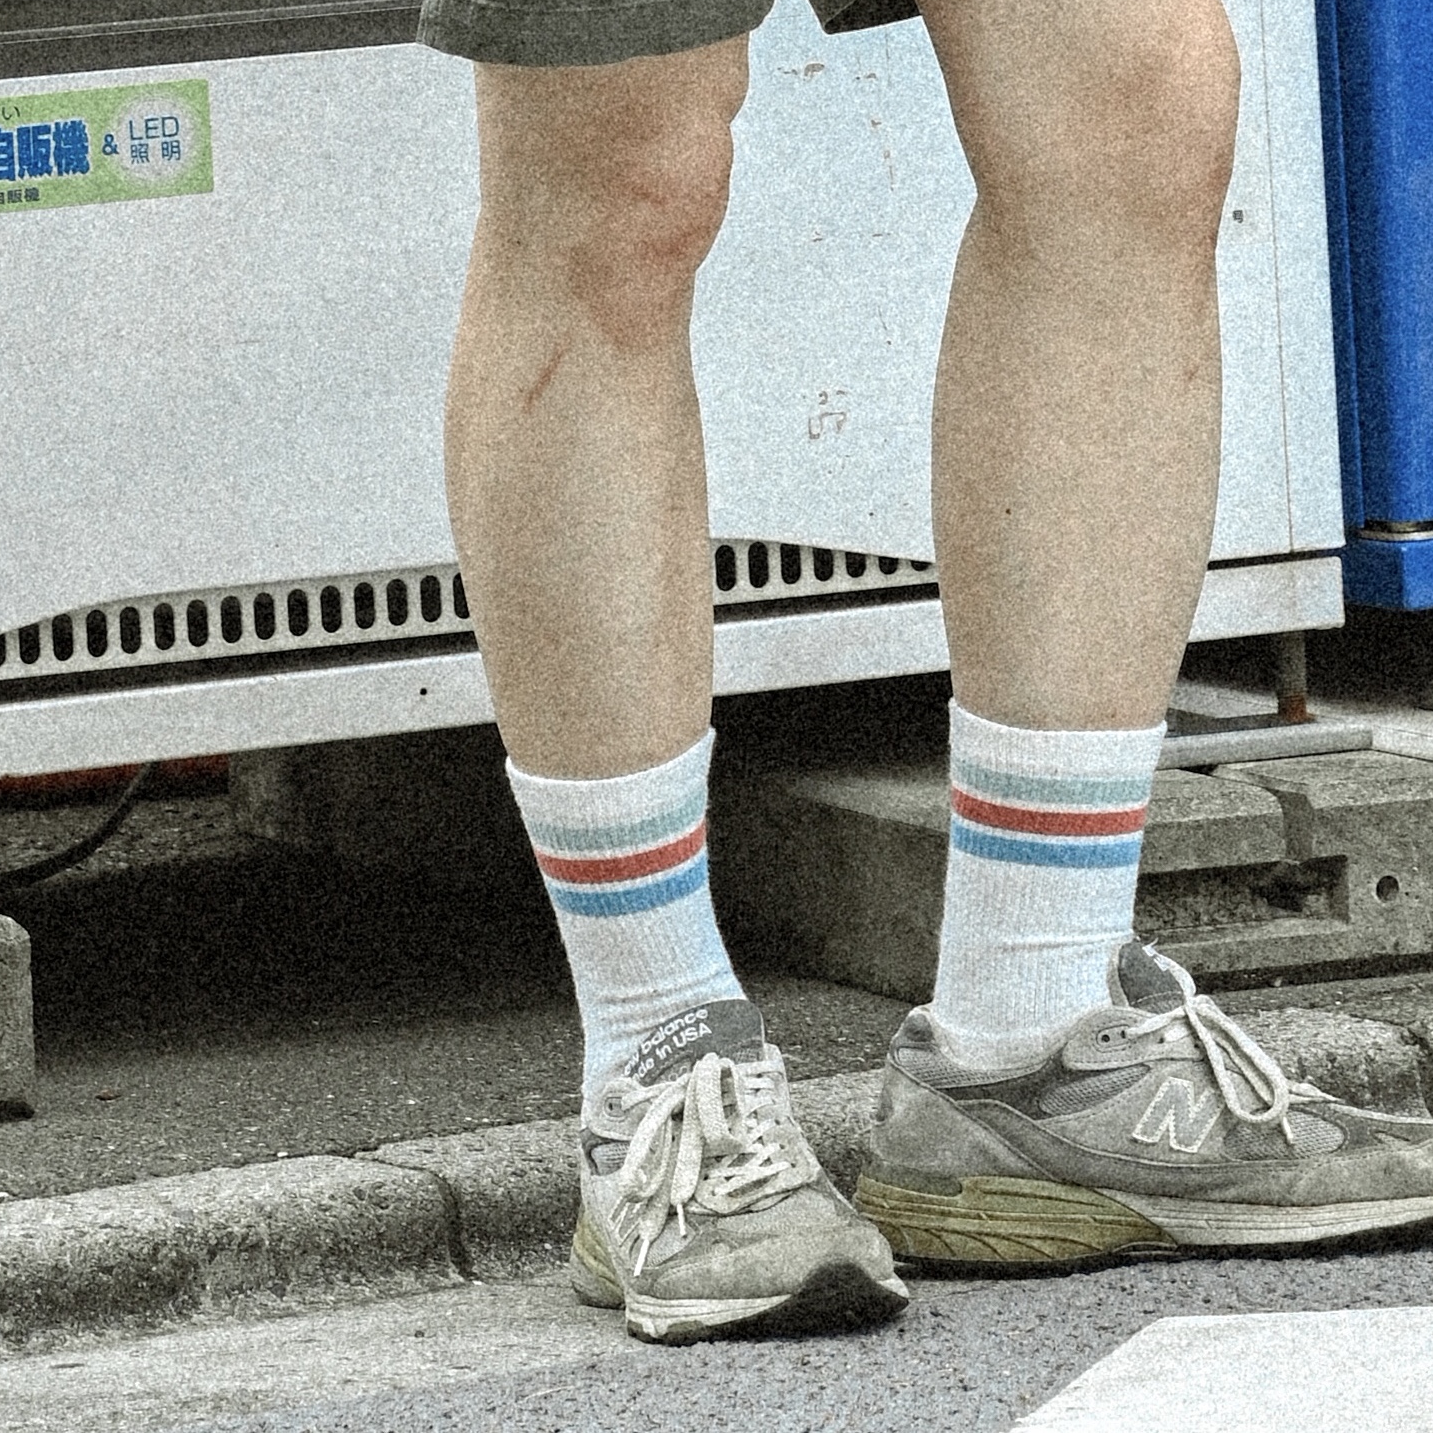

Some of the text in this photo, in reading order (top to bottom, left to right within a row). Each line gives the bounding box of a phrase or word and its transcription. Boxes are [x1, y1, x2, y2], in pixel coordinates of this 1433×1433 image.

[128, 116, 180, 140] LED
[130, 141, 182, 164] 照明
[641, 1009, 709, 1055] balance
[673, 1022, 713, 1048] USA
[1132, 1077, 1224, 1155] N
